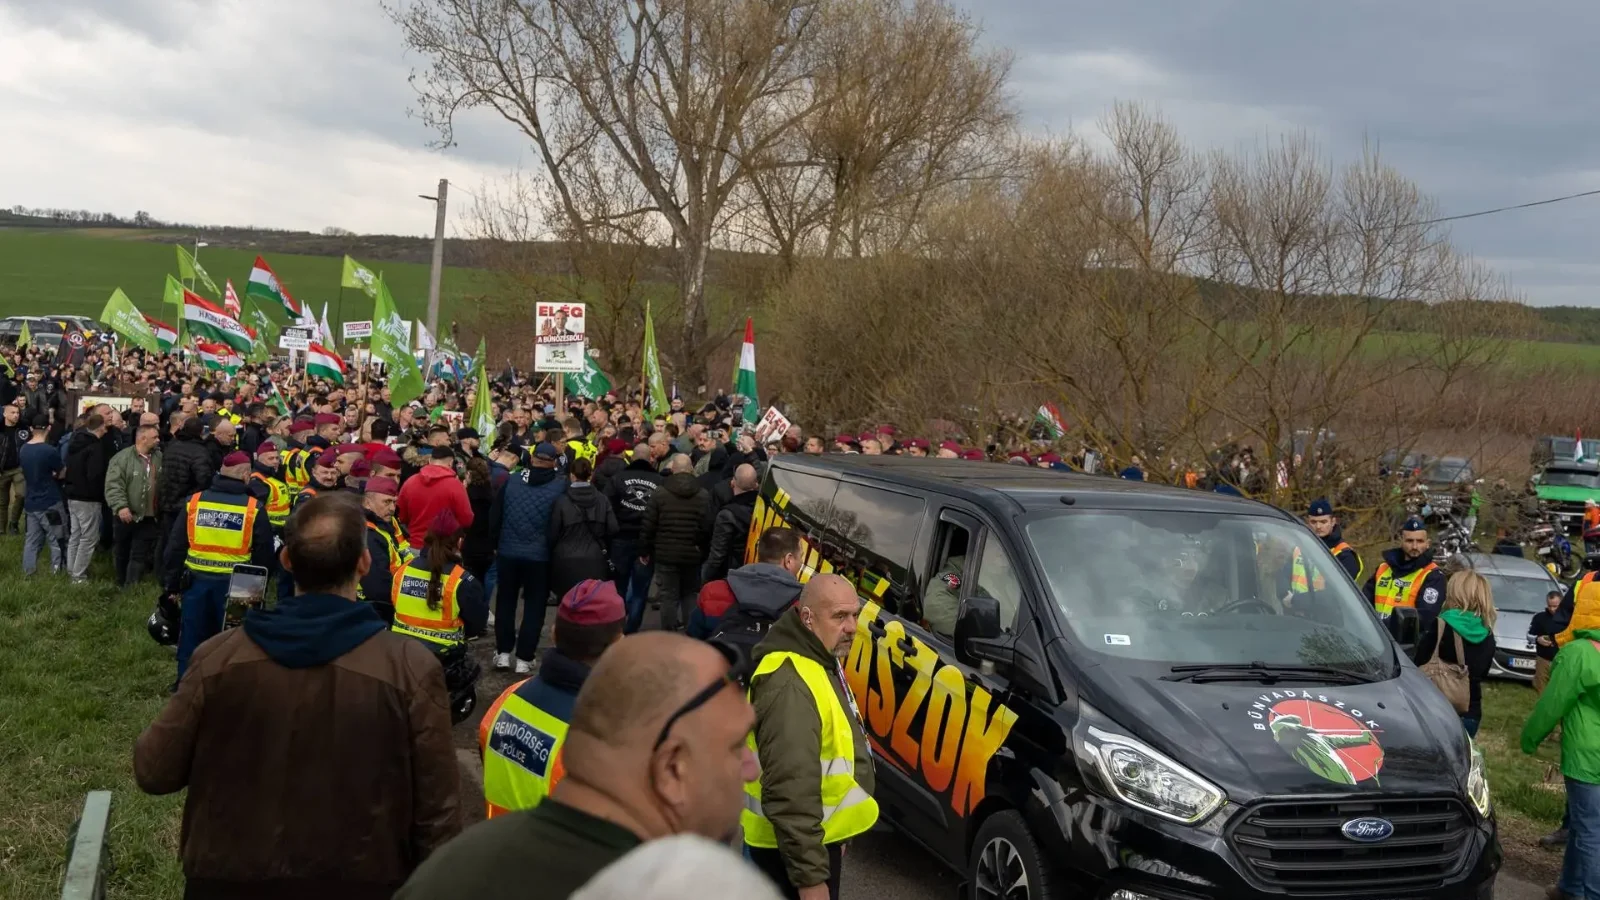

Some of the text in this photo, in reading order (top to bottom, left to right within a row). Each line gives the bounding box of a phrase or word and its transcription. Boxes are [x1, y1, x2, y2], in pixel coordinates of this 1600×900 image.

[538, 304, 583, 318] ELÉG
[1247, 690, 1379, 731] BŰNVADÁSZOK
[494, 721, 549, 763] RENDŐRSÉG
[502, 742, 526, 763] POLICE
[1356, 821, 1384, 836] Ford
